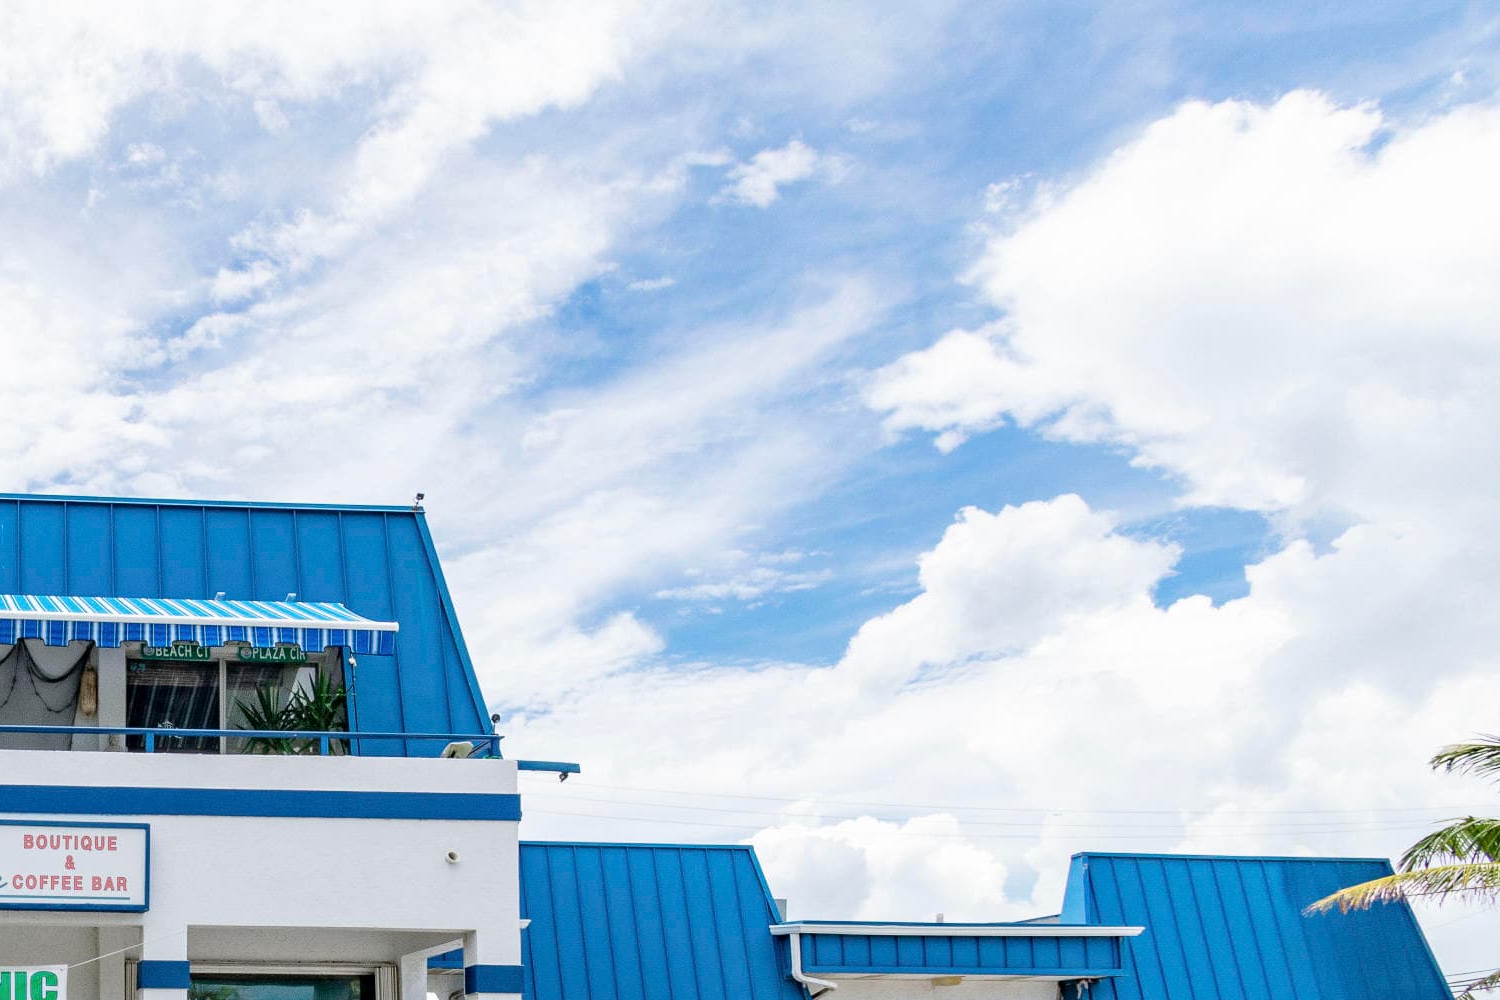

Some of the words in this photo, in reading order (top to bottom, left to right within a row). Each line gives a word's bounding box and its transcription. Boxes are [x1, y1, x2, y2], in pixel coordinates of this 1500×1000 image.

[155, 645, 192, 657] BEACH
[252, 647, 286, 660] PLAZA
[290, 647, 306, 660] CIR
[23, 834, 118, 852] BOUTIQUE
[65, 855, 76, 871] &
[12, 875, 83, 891] COFFEE
[91, 876, 128, 892] BAR
